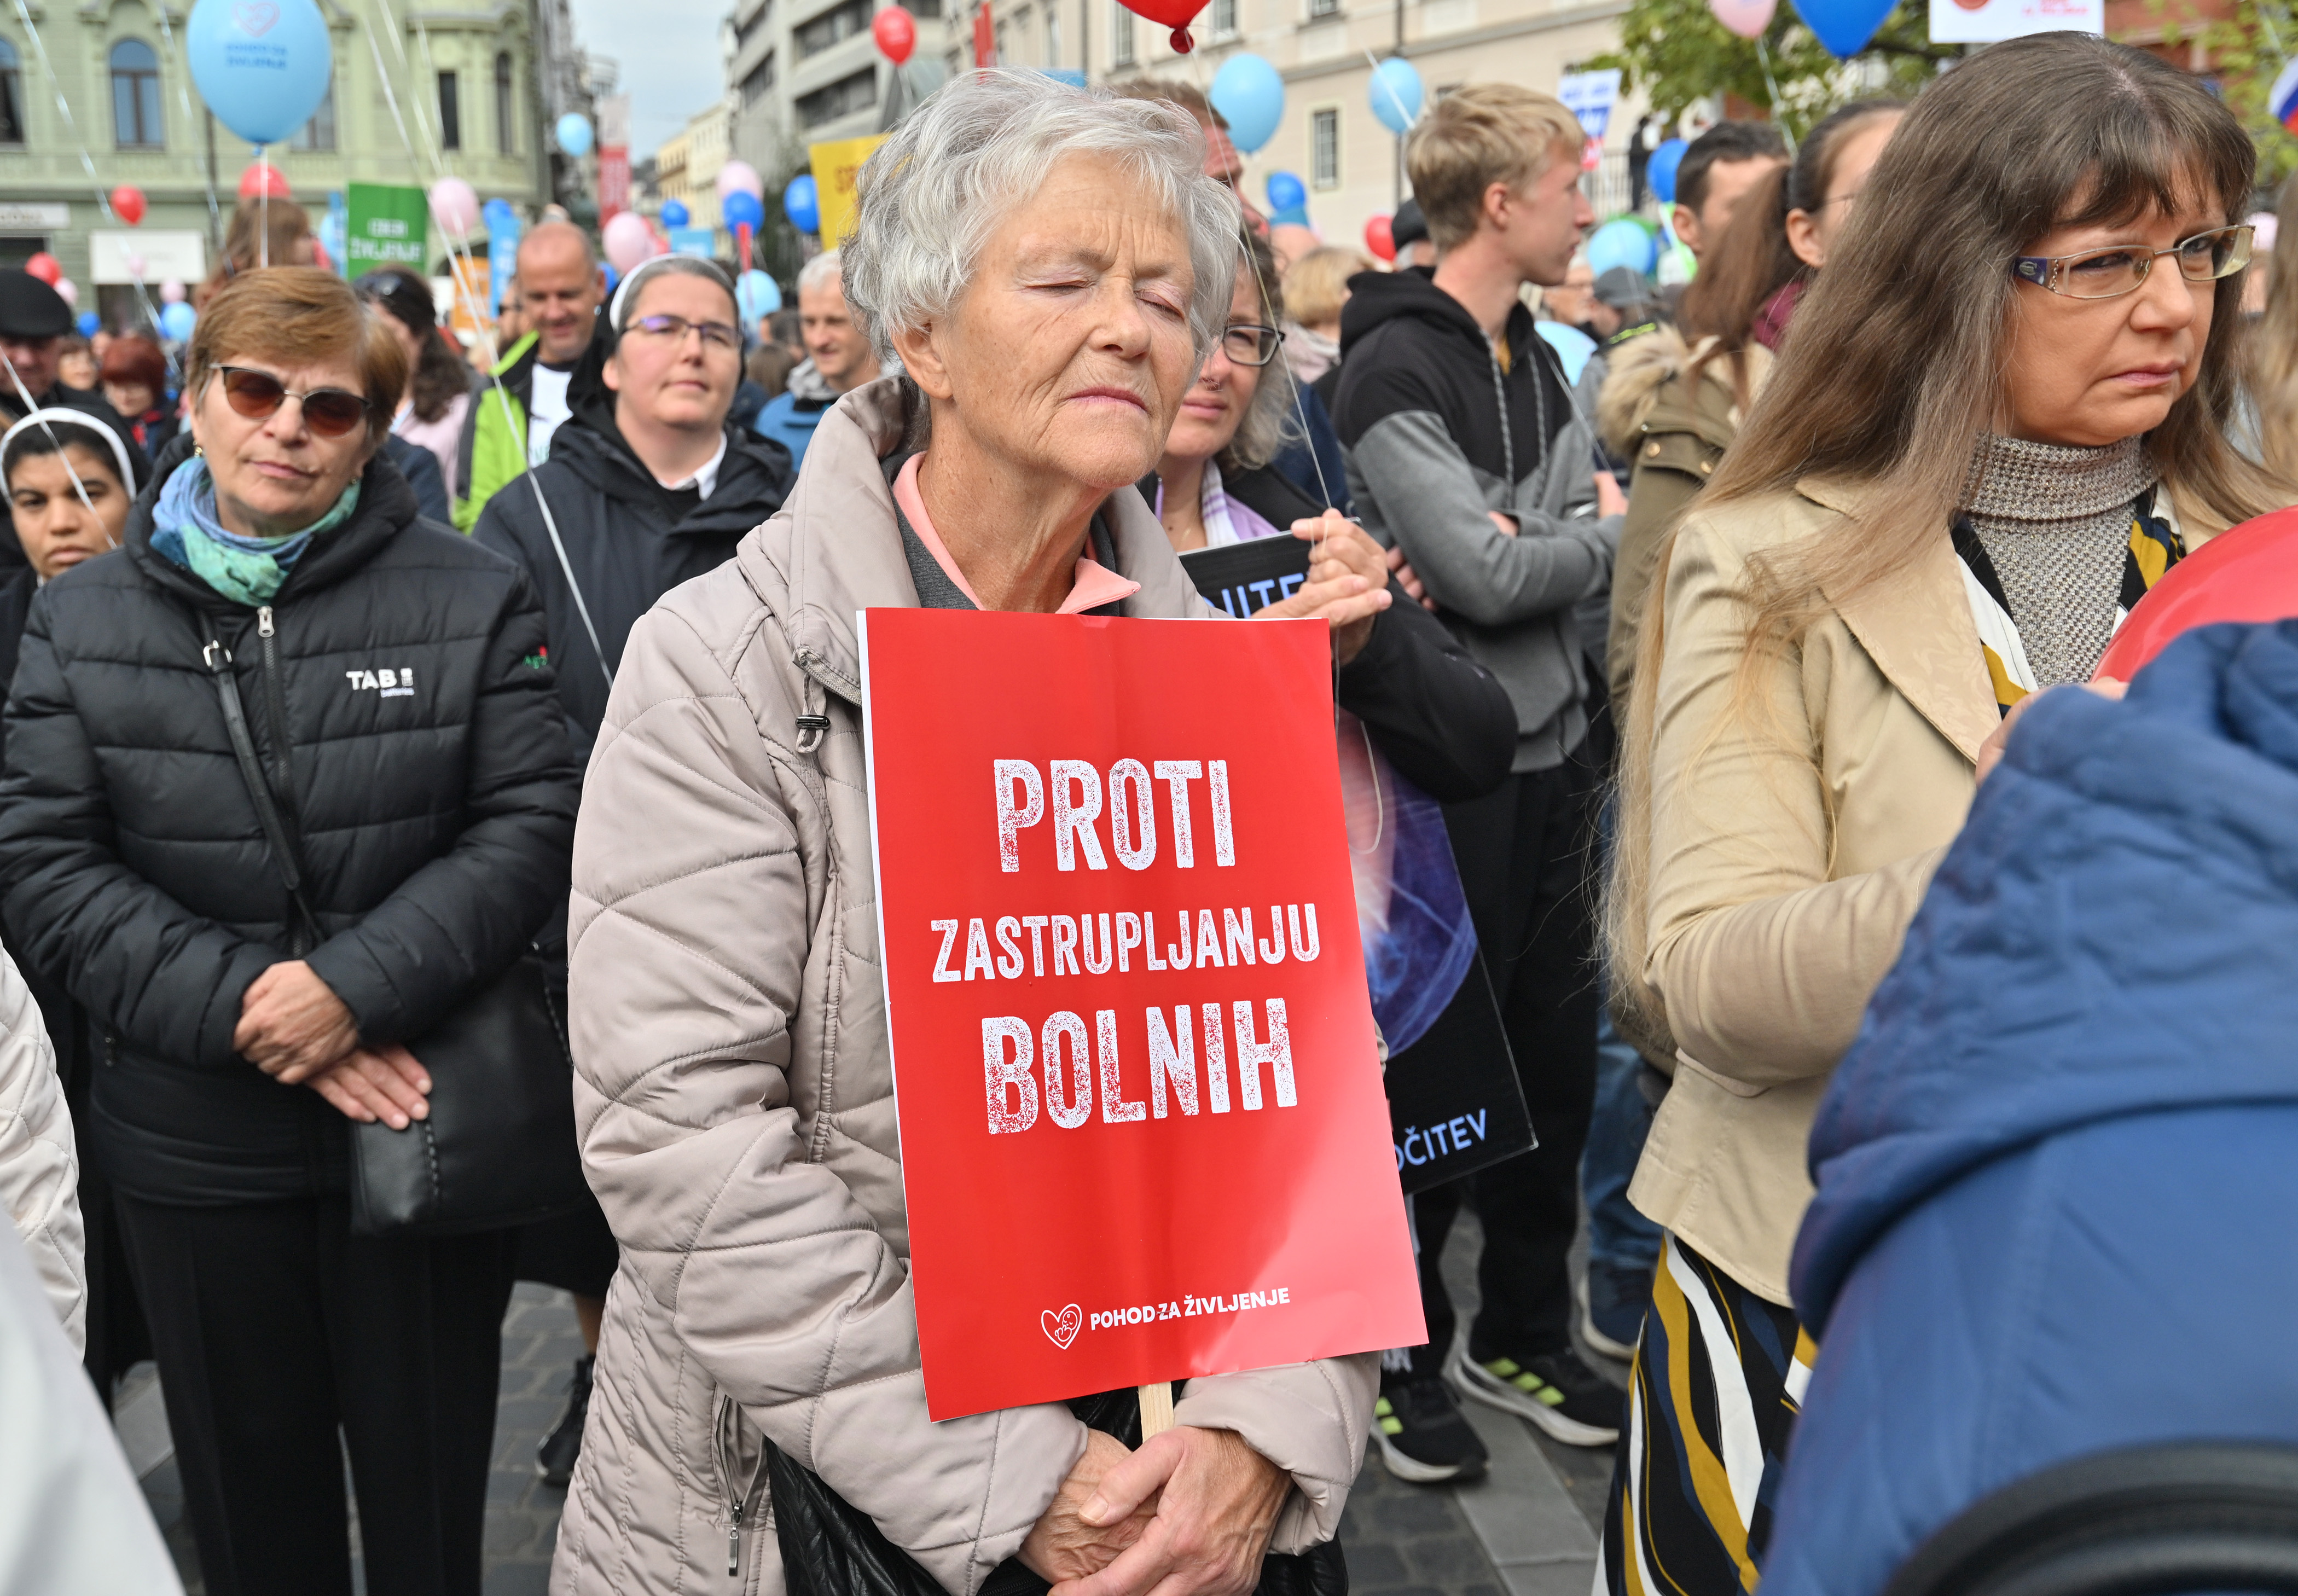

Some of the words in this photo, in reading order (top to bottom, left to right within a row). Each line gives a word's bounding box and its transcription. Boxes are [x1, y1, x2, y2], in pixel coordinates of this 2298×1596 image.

[346, 669, 397, 690] TAB
[994, 758, 1235, 873] PROTI
[931, 903, 1320, 983] ZASTRUPLJANJU
[982, 997, 1298, 1135] BOLNIH
[1090, 1306, 1155, 1331] POHOD
[1158, 1302, 1181, 1321] ZA
[1184, 1287, 1290, 1316] ŽIVLJENJE
